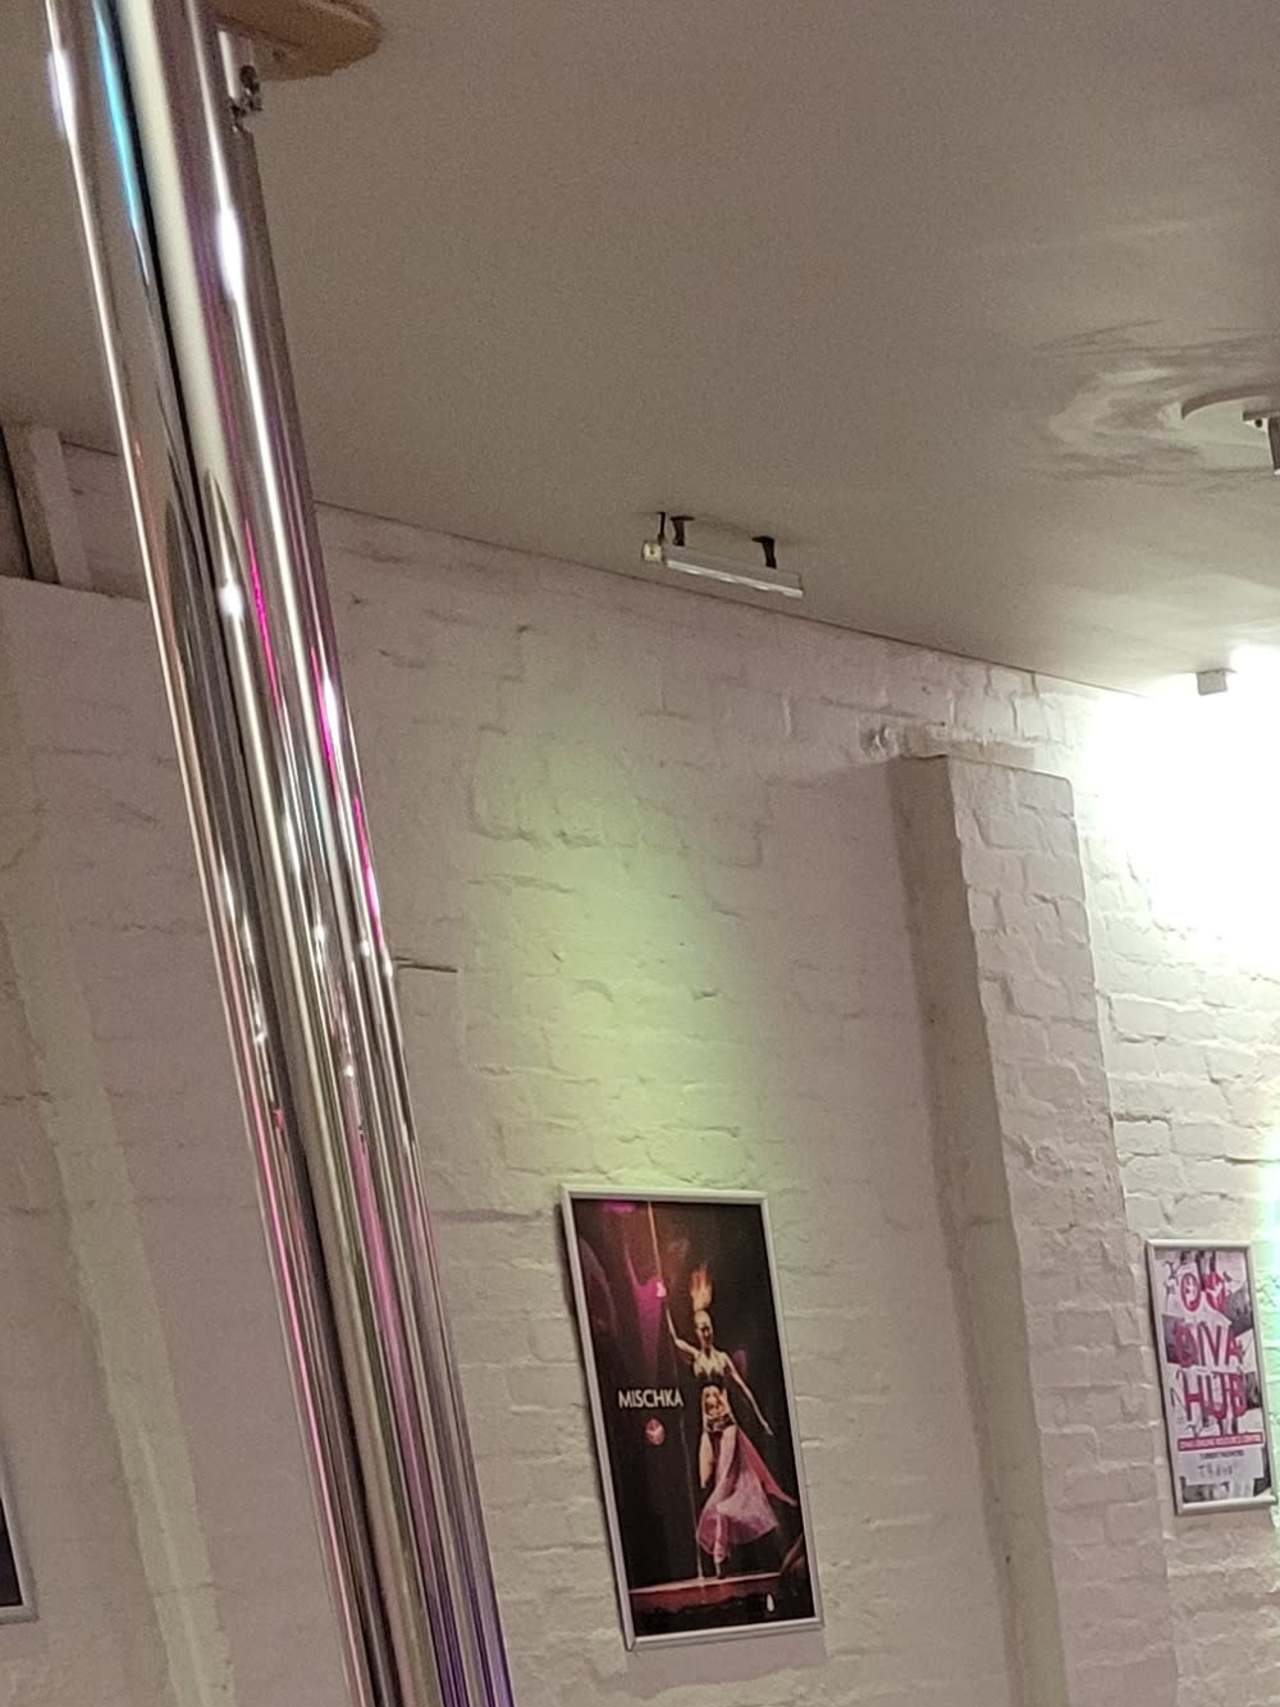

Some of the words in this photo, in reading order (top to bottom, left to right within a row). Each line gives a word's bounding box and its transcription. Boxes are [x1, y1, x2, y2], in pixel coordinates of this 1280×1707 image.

[1173, 1322, 1245, 1368] DIVA
[618, 1388, 684, 1409] MISCHKA
[1181, 1371, 1248, 1421] HUB
